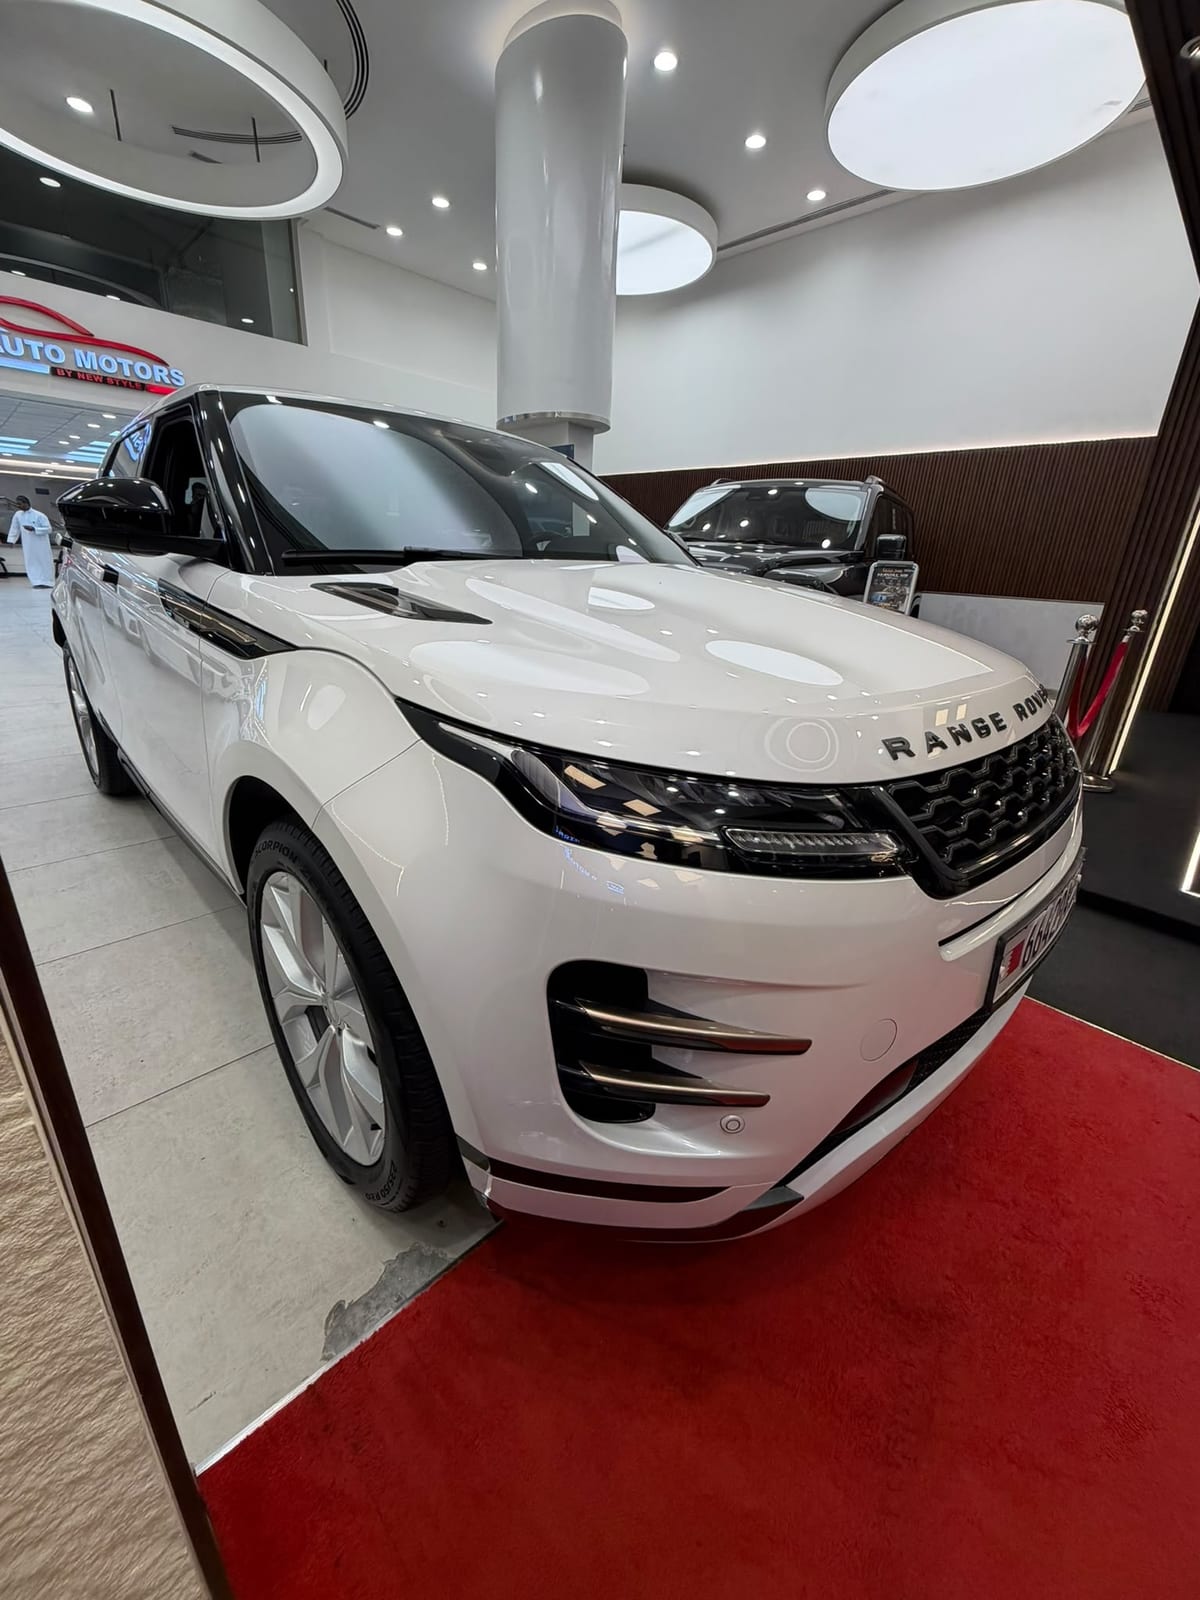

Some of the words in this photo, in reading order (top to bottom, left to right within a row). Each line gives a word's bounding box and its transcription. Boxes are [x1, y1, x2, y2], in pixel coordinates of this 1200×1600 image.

[0, 334, 66, 364] UTO
[73, 348, 186, 387] MOTORS
[56, 367, 73, 378] BY
[77, 371, 103, 383] NEW
[106, 376, 144, 391] STYLE
[881, 711, 1007, 761] RANGE
